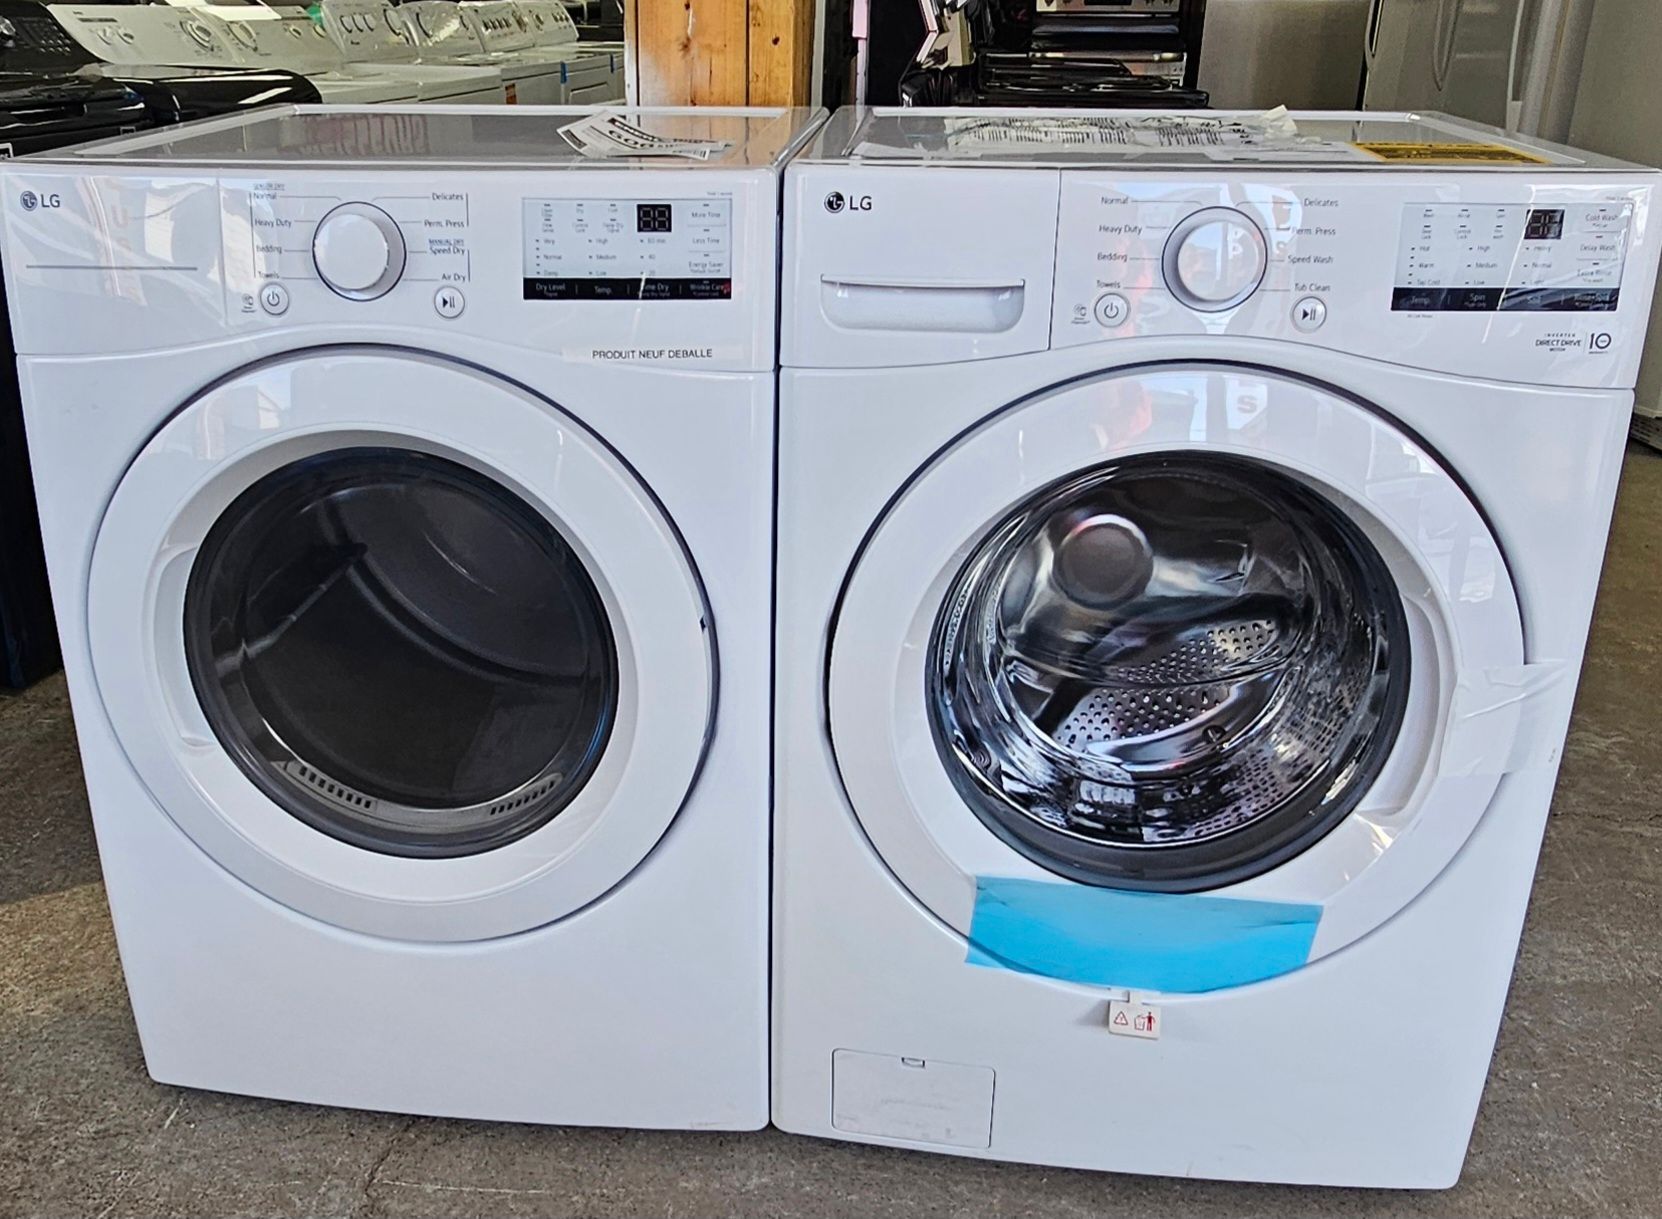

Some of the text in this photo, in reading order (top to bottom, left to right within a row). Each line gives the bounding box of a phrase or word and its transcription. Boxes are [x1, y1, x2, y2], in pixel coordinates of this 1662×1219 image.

[41, 194, 60, 208] LG
[432, 193, 464, 201] Delicates
[849, 195, 872, 211] LG
[1304, 198, 1339, 207] Delicates
[255, 219, 292, 228] Heavy Duty
[446, 220, 465, 228] Press
[1099, 225, 1142, 235] Heavy Duty
[1315, 227, 1336, 235] Press
[453, 247, 465, 255] Dry
[1097, 252, 1127, 262] Bedding
[1288, 255, 1311, 264] Speed
[454, 273, 466, 282] Dry
[1097, 280, 1120, 288] Towels
[1294, 283, 1330, 291] Tub Clean
[1535, 339, 1582, 347] DIRECT DRIVE
[592, 348, 713, 360] PRODUIT NEUF DEBALLE
